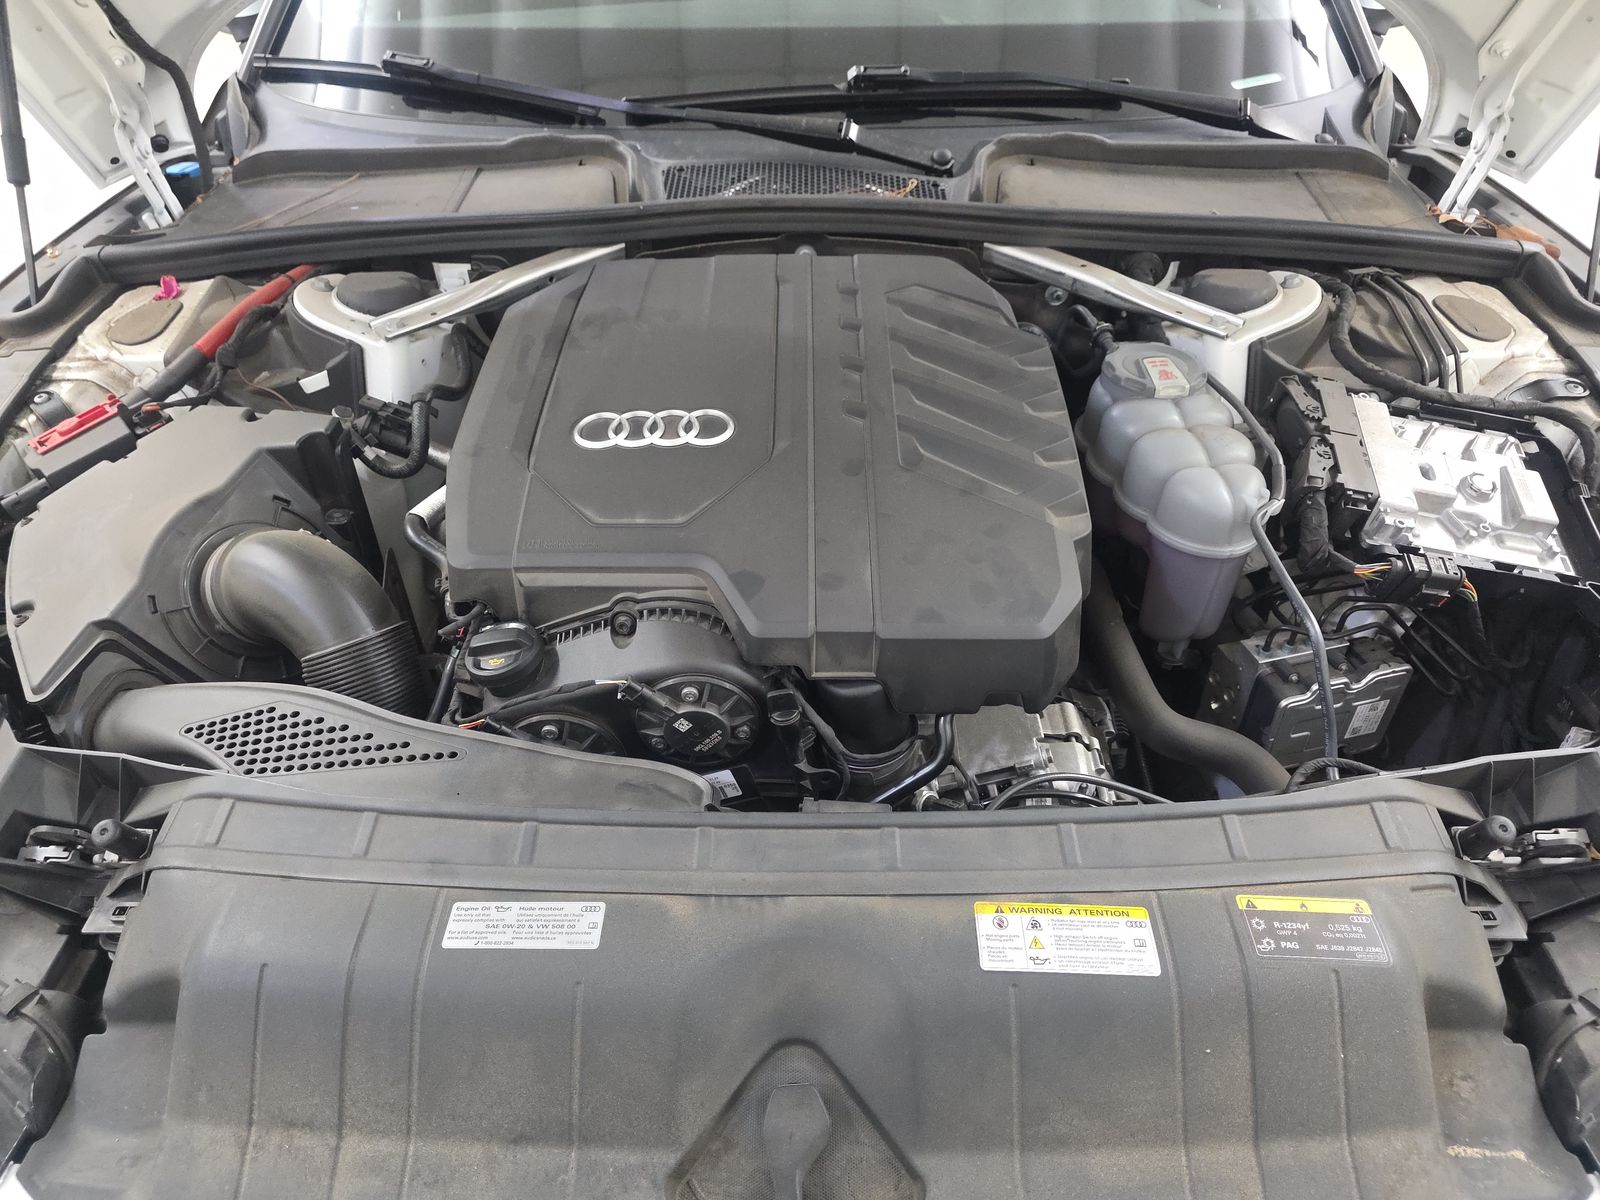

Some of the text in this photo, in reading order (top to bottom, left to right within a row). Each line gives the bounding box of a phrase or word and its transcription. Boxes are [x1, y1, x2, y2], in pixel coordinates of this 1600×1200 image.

[1008, 906, 1130, 917] WARNING ATTENTION
[1273, 921, 1310, 931] R-1234yf
[1352, 925, 1363, 933] kg
[1280, 941, 1300, 950] PAG
